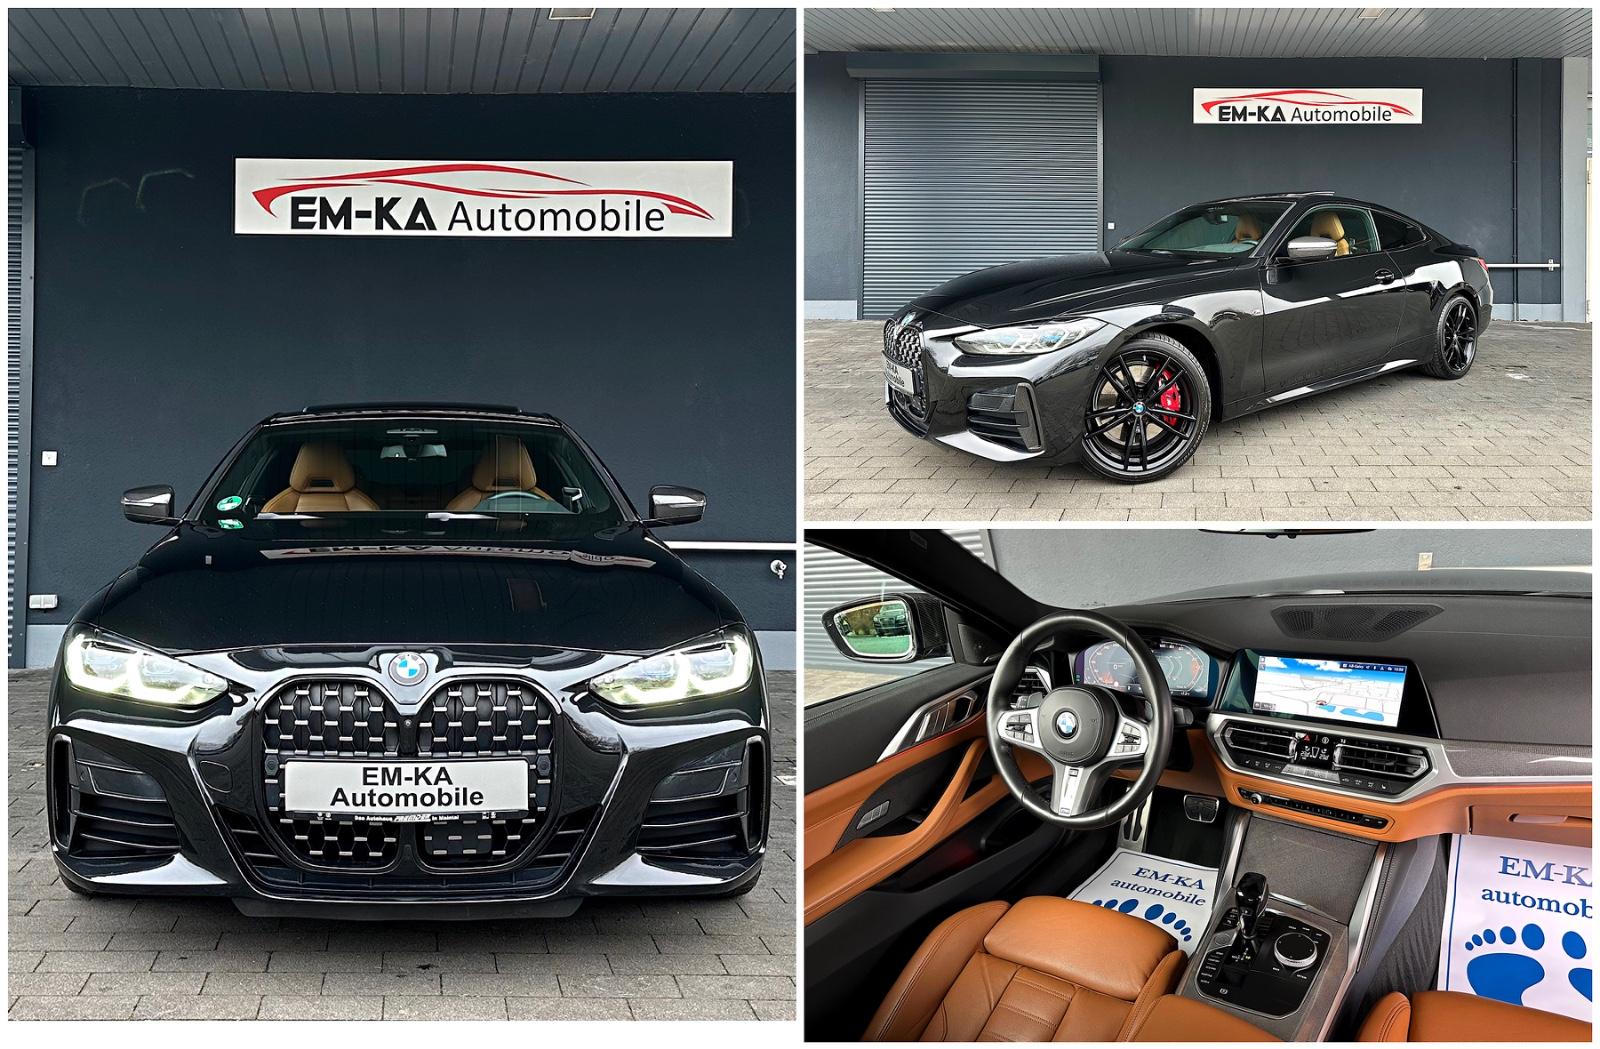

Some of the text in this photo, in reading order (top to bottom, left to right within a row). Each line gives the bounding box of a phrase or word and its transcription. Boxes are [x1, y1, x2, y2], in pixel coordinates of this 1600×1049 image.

[1218, 105, 1392, 122] EM-KA Automobile
[290, 196, 665, 232] EM-KA Automobile
[362, 766, 453, 786] EM-KA
[330, 787, 484, 807] Automobile
[1132, 866, 1206, 890] EM-KA
[1498, 855, 1592, 888] EM-K
[1110, 879, 1206, 906] automobile
